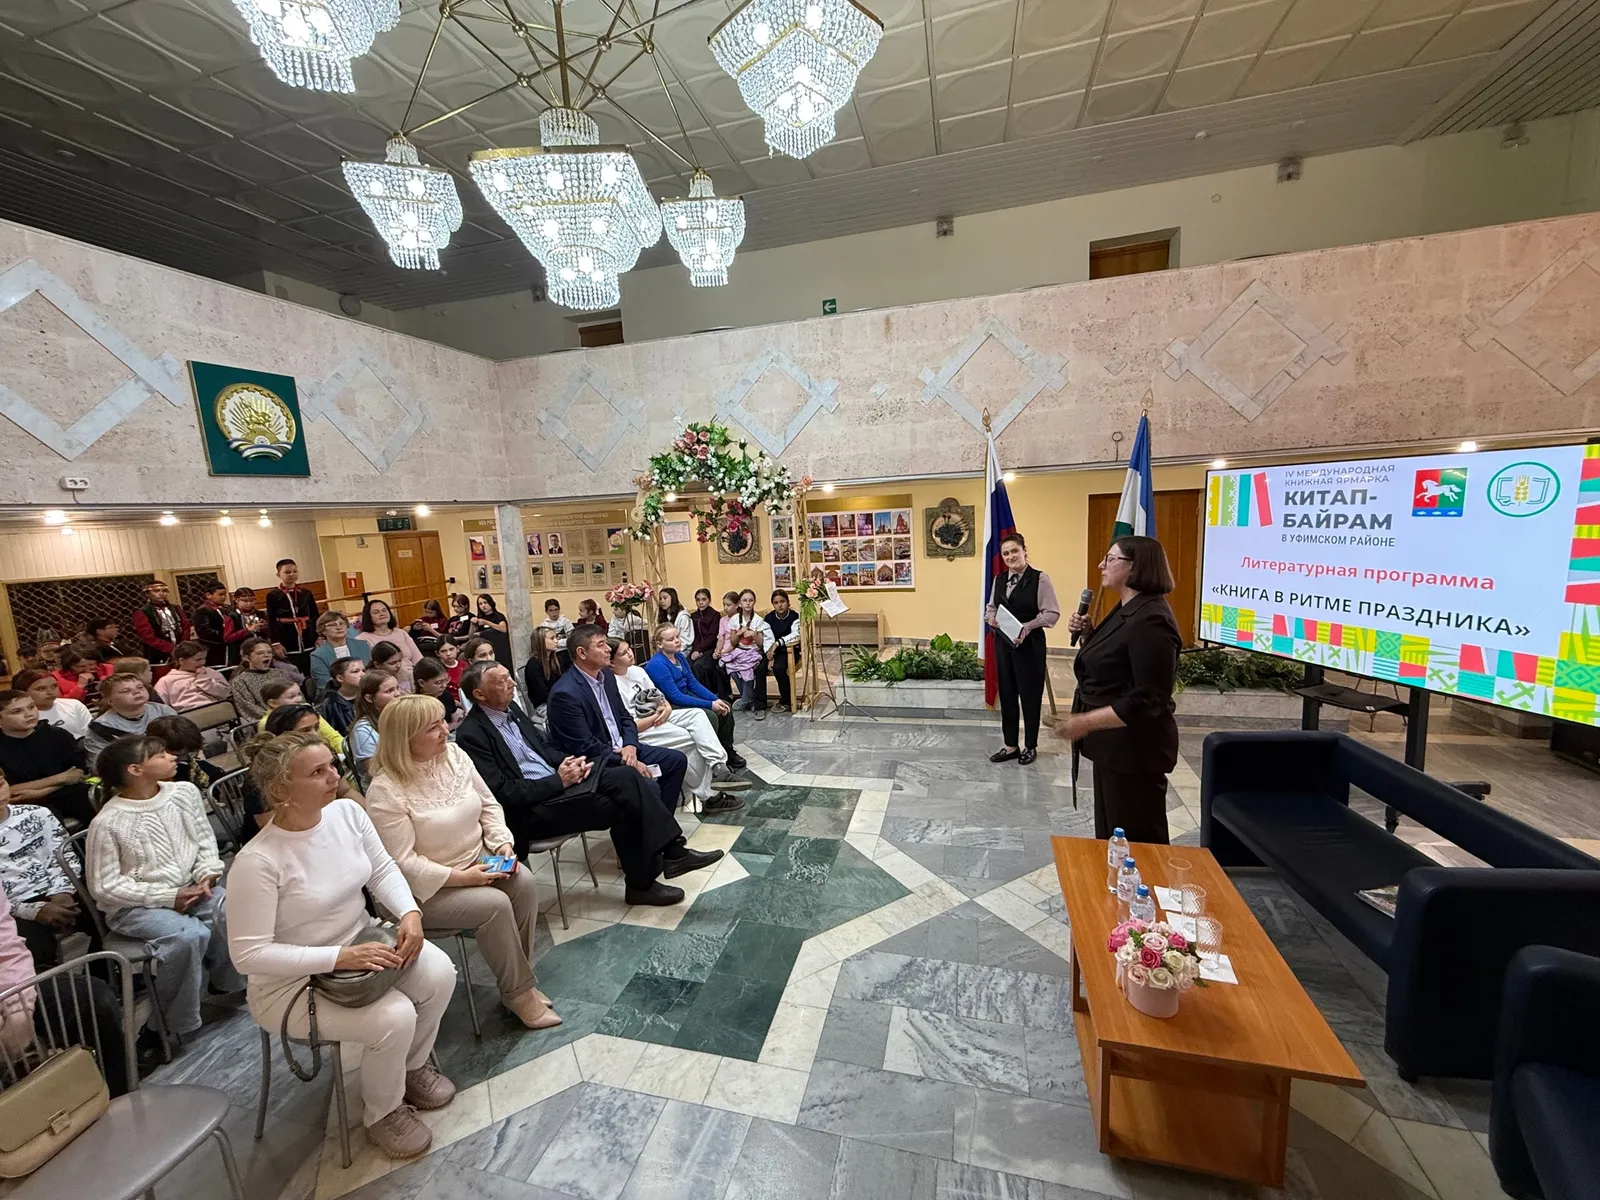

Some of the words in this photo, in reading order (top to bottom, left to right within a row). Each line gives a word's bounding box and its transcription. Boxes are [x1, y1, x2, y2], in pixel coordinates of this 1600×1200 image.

[1285, 470, 1295, 478] IV
[1296, 464, 1396, 477] МЕЖДУНАРОДНАЯ
[1284, 477, 1333, 486] КНИЖНАЯ
[1336, 475, 1390, 484] ЯРМАРКА
[1284, 488, 1378, 506] КИТАП-
[1282, 508, 1393, 531] БАЙРАМ
[1281, 533, 1288, 543] В
[1290, 534, 1347, 545] УФИМСКОМ
[1349, 534, 1396, 548] РАЙОНЕ
[1241, 556, 1358, 578] Литературная
[1363, 567, 1495, 591] программа
[1211, 583, 1270, 602] «КНИГА
[1274, 590, 1284, 604] В
[1289, 592, 1352, 613] РИТМЕ
[1358, 600, 1531, 637] ПРАЗДНИКА»
